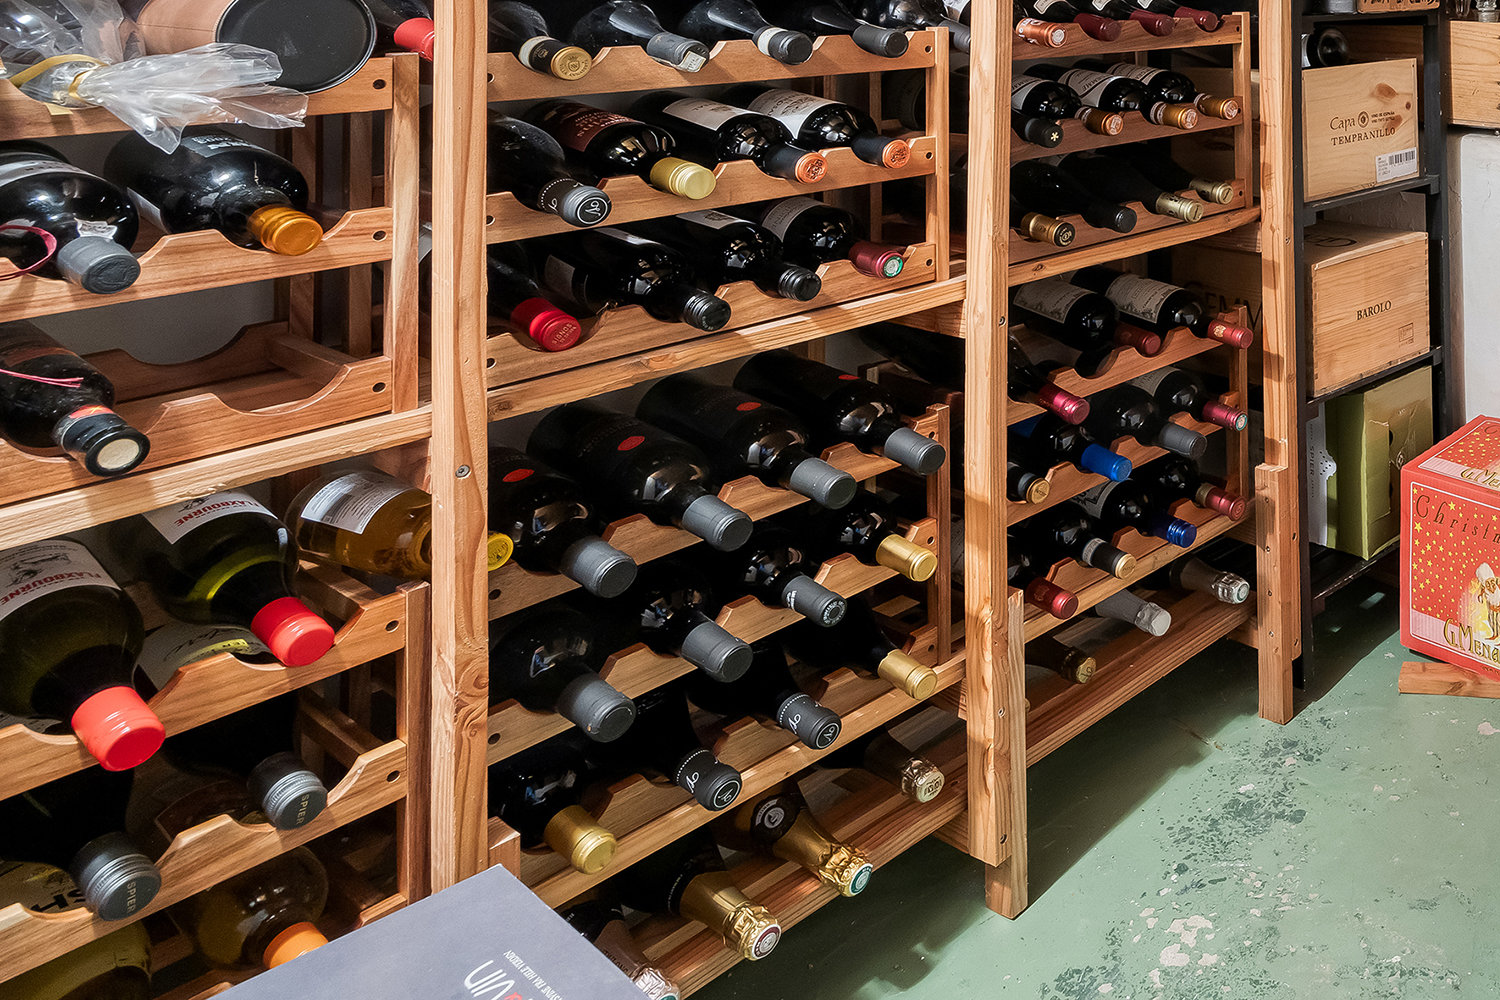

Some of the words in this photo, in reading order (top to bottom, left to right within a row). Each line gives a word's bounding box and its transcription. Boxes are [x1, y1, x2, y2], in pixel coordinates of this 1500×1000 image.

[1329, 116, 1356, 132] Capa
[1330, 127, 1396, 146] TEMPRANILLO
[1356, 300, 1392, 321] BAROLO
[297, 793, 310, 825] SPIER
